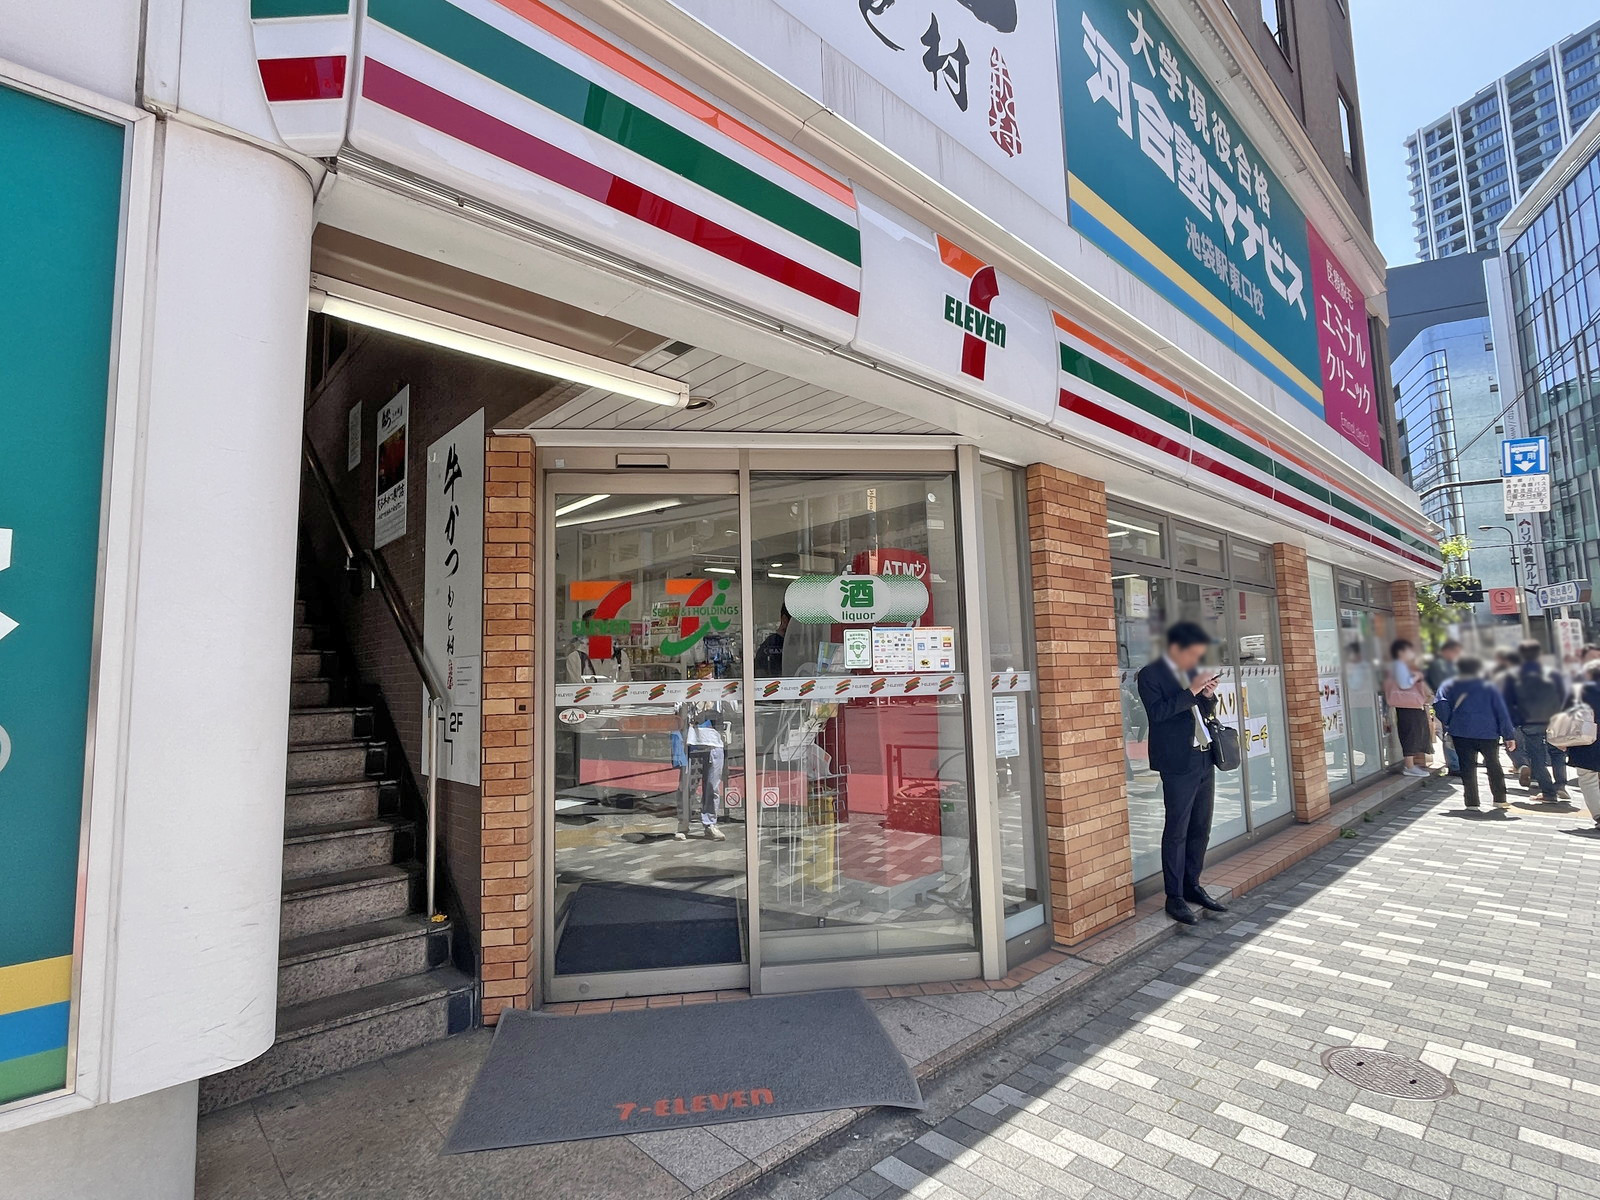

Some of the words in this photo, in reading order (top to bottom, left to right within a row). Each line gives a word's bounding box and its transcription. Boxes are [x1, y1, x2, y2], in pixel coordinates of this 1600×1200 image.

[1127, 9, 1271, 219] 大学現役合格
[1082, 11, 1307, 321] 河合塾マナビス
[1185, 216, 1266, 320] 池袋駅東口校
[1321, 294, 1366, 369] エミナル
[1326, 346, 1371, 415] クリニック
[1514, 452, 1536, 461] 専用
[882, 560, 915, 576] ATM
[840, 579, 874, 608] 酒
[693, 605, 739, 616] HOLDINGS
[842, 611, 876, 622] liquor
[449, 712, 463, 732] 2F
